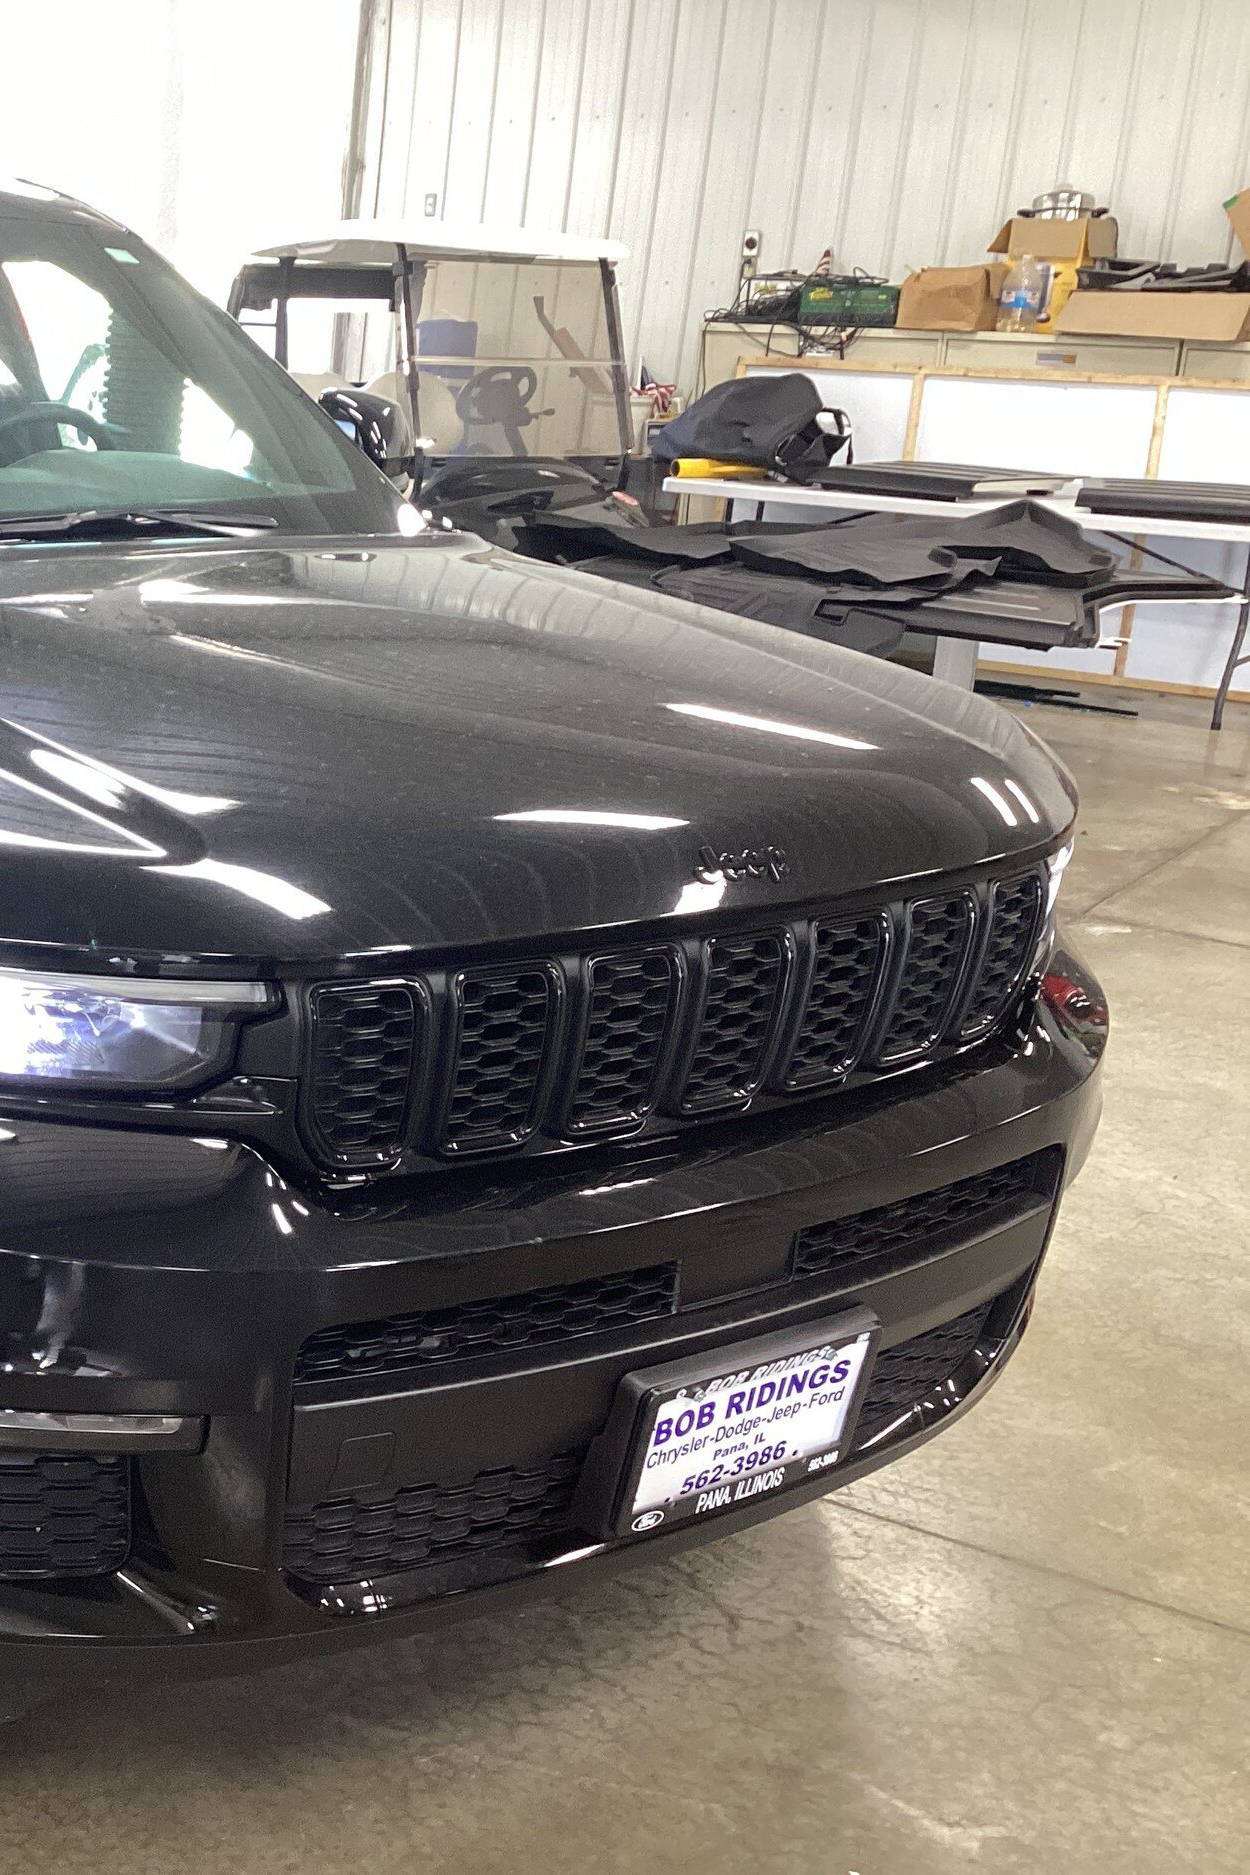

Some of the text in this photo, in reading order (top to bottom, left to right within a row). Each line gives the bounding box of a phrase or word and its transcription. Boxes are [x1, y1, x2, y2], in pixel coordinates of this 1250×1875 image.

[692, 846, 788, 885] Jeep
[653, 1360, 851, 1447] BOB RIDINGS
[647, 1388, 845, 1469] Chrysler-Dodge-Jeep-Ford
[712, 1433, 766, 1462] Pana, IL
[680, 1441, 787, 1495] 562-3986
[734, 1468, 785, 1500] ILLINOIS
